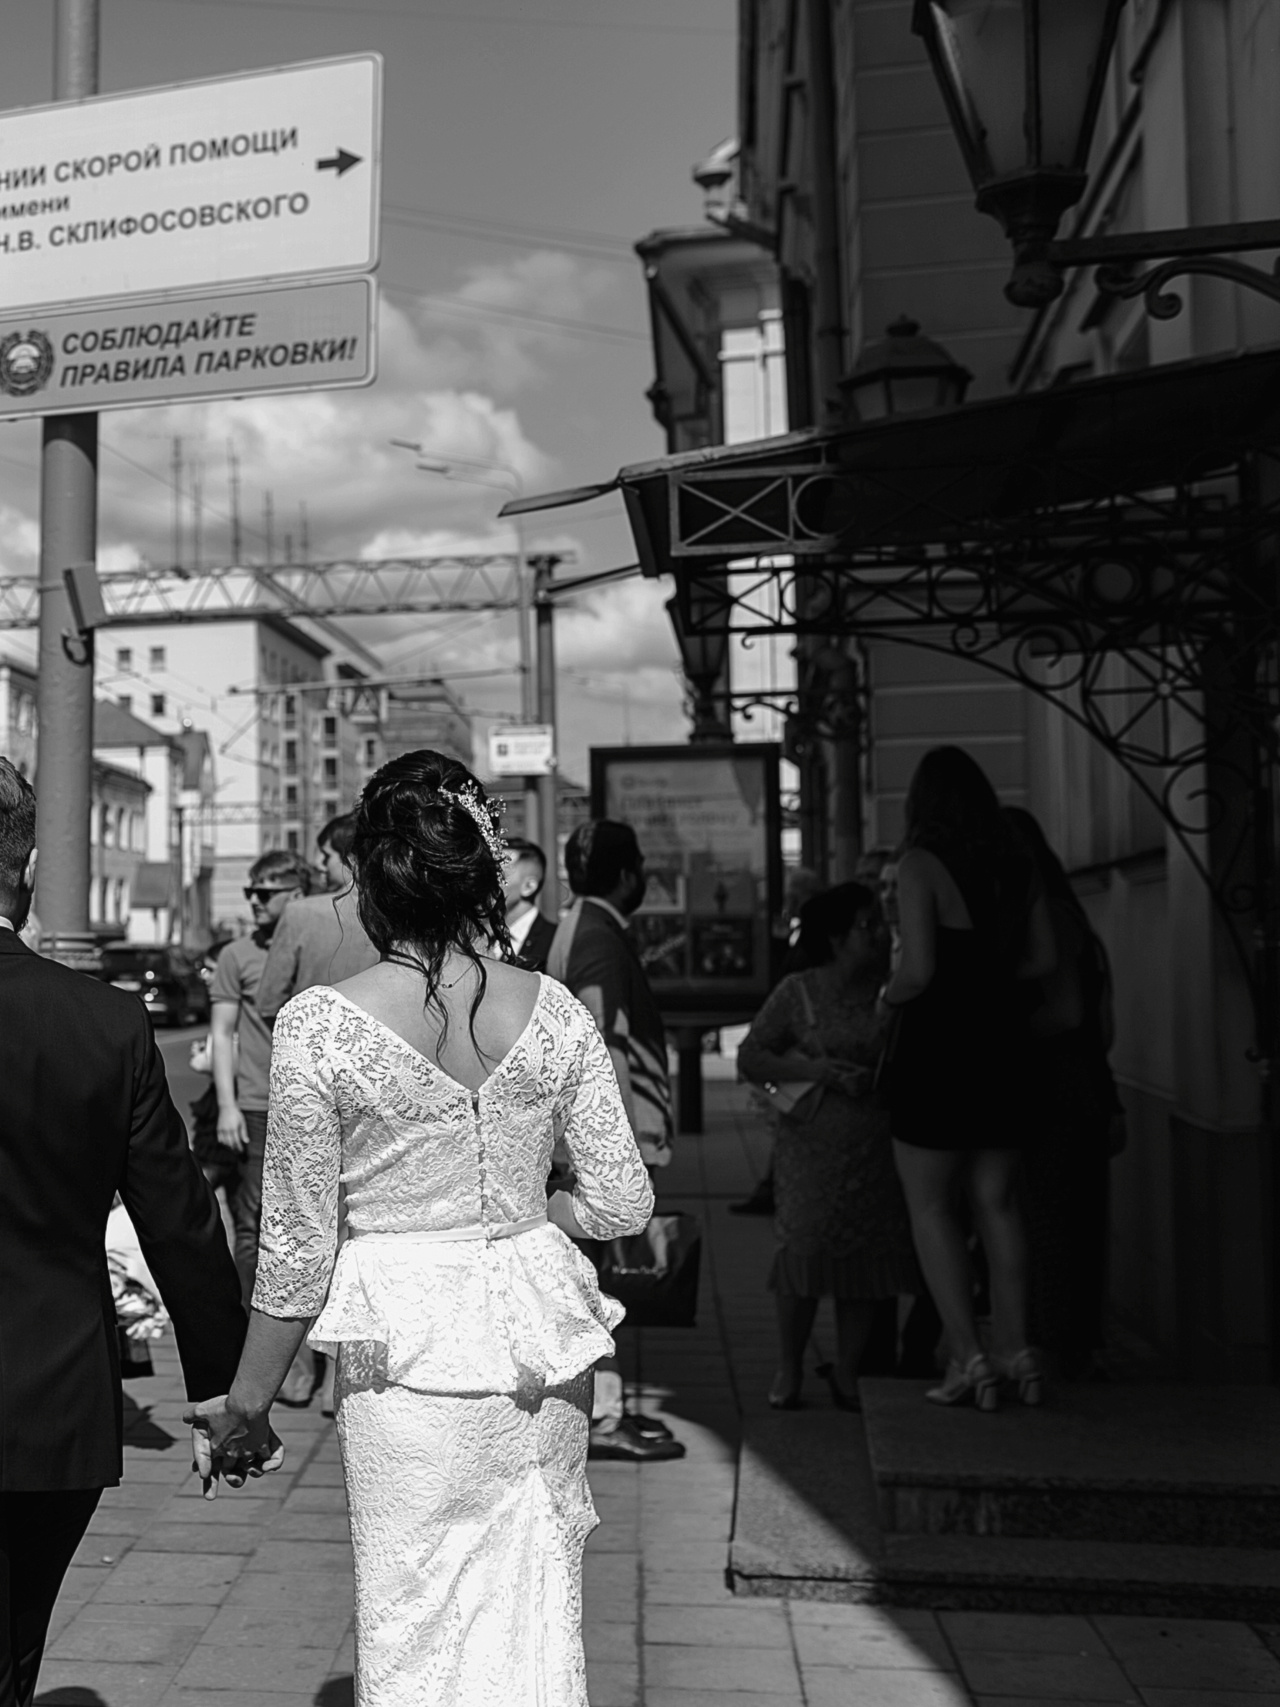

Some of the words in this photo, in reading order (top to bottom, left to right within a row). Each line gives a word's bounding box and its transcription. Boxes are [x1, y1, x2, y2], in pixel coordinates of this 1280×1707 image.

[53, 144, 161, 184] СКОРОЙ
[169, 127, 299, 167] ПОМОЩИ
[48, 191, 310, 248] СКЛИФОСОВСКОГО
[61, 312, 257, 353] СОБЛЮДАЙТЕ
[59, 355, 186, 387] ПРАВИЛА
[195, 336, 357, 374] ПАРКОВКИ!
